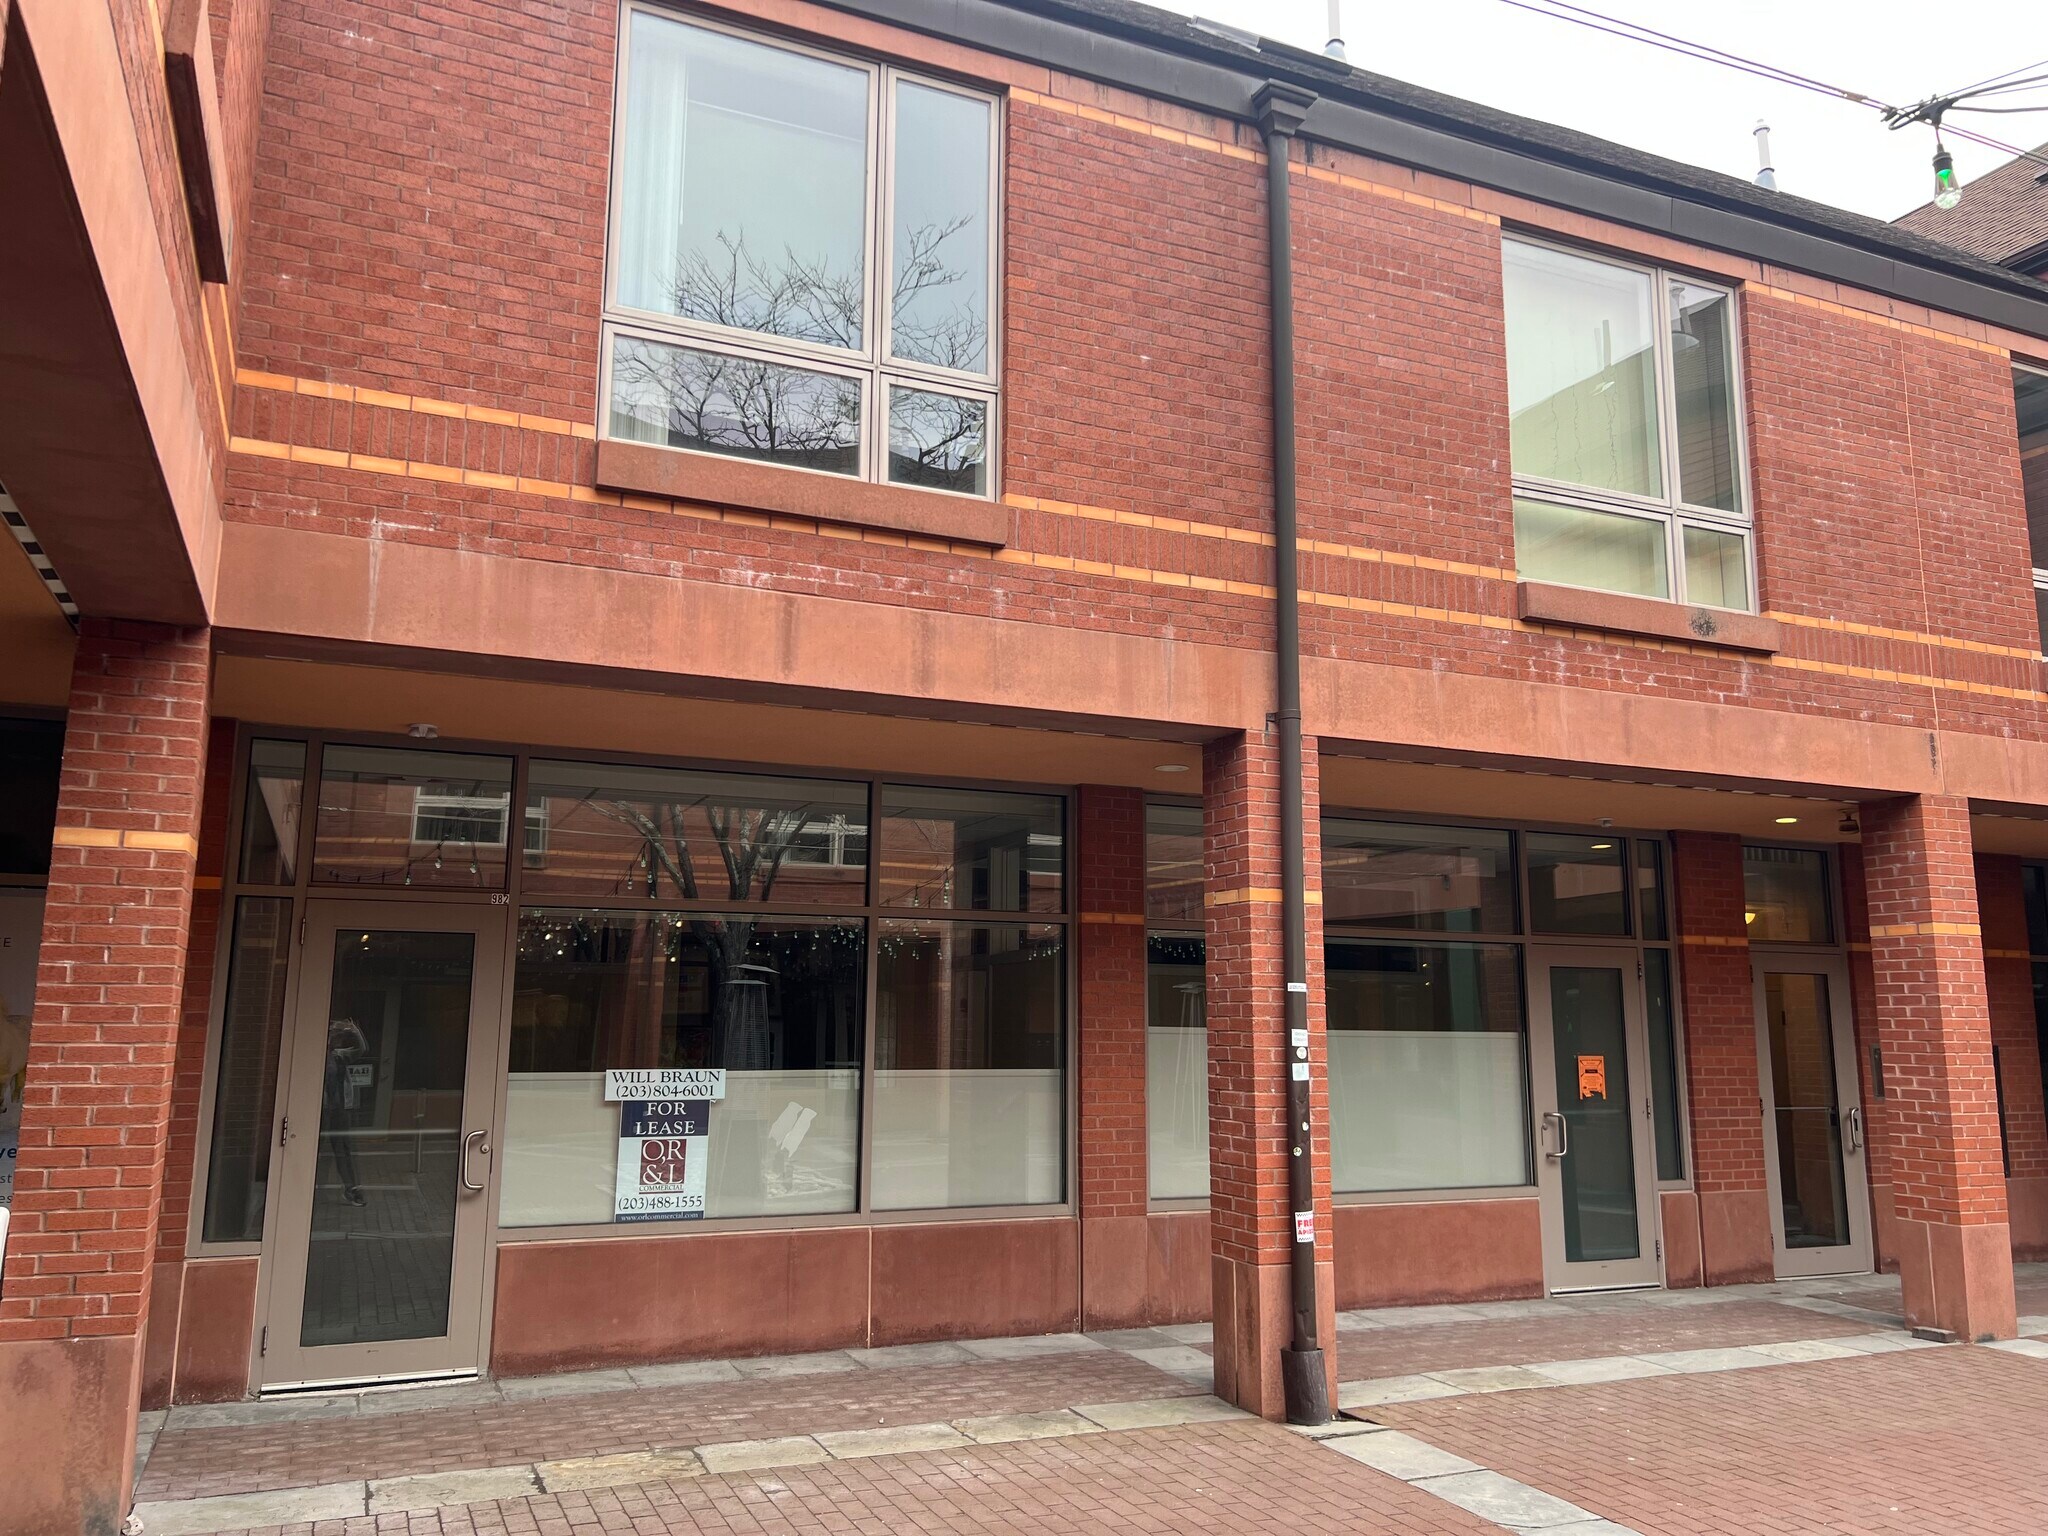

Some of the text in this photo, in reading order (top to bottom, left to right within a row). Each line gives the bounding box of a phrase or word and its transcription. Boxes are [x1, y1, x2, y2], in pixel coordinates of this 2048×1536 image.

[491, 894, 509, 904] 982
[612, 1070, 720, 1083] WILL BRAUN
[616, 1084, 714, 1099] (203)804-6001
[647, 1101, 687, 1116] FOR
[635, 1120, 695, 1135] LEASE
[639, 1184, 684, 1192] COMMERCIAL
[618, 1195, 702, 1211] (203)488-1555
[621, 1212, 699, 1221] www.orlcommercial.com
[1297, 1219, 1314, 1228] FRE
